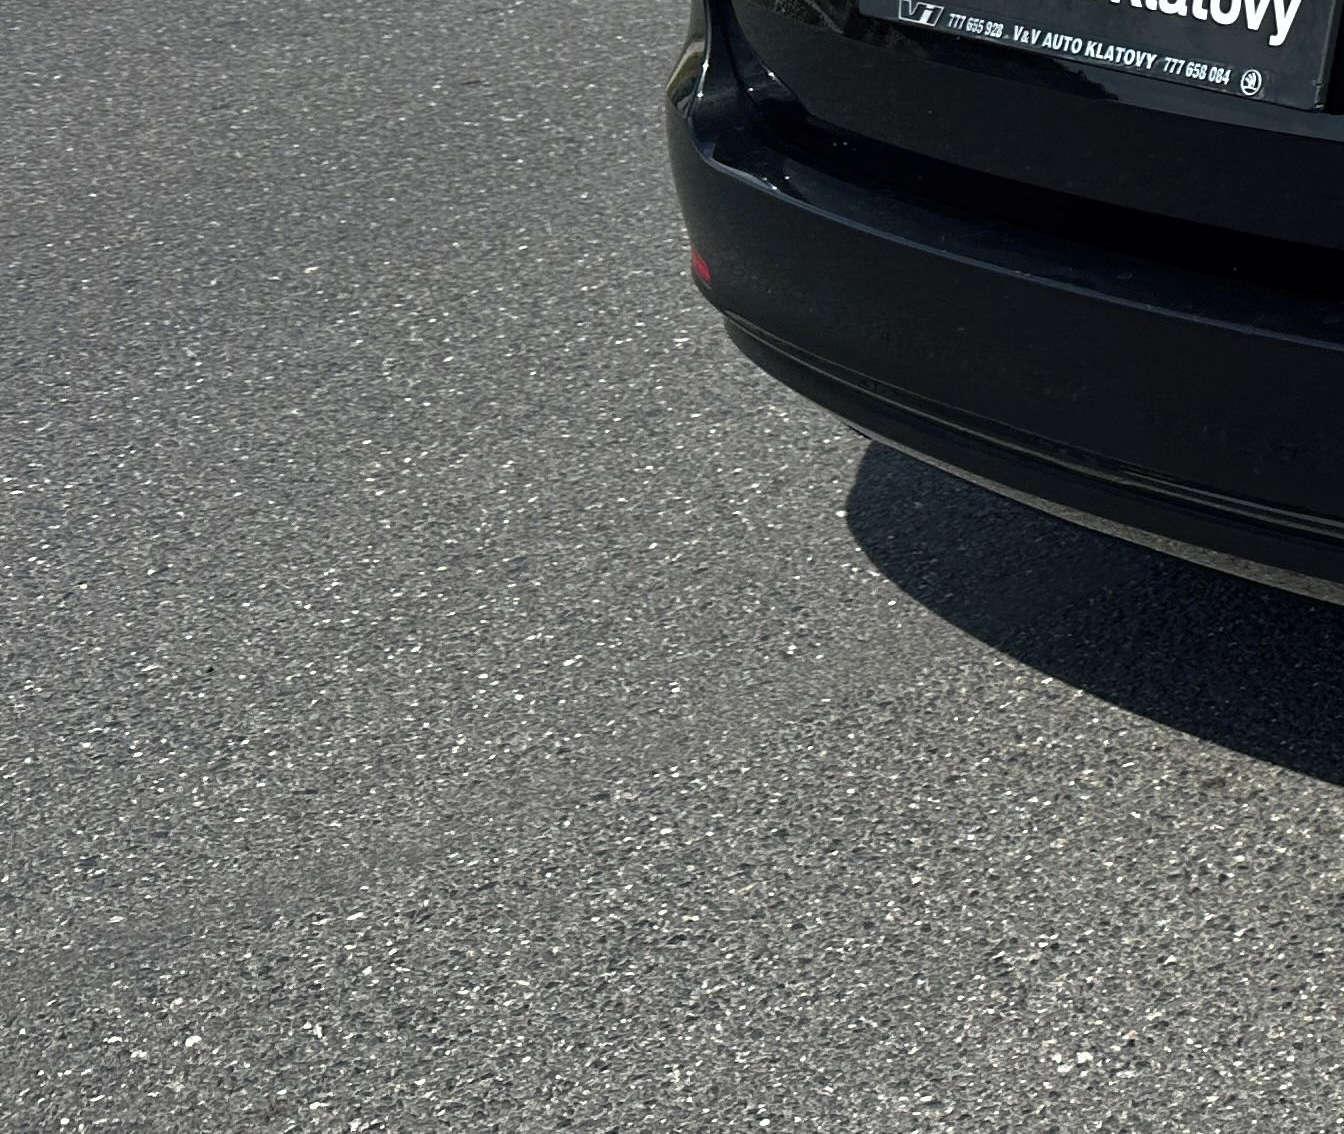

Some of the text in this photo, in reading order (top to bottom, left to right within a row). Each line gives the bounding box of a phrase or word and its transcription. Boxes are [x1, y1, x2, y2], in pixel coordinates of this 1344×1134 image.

[948, 13, 967, 29] 777
[1013, 25, 1041, 45] V&V
[1042, 32, 1083, 54] AUTO
[1084, 40, 1158, 69] KLATOVY
[1163, 57, 1185, 75] 777
[1186, 62, 1208, 80] 658
[1208, 66, 1231, 85] 084
